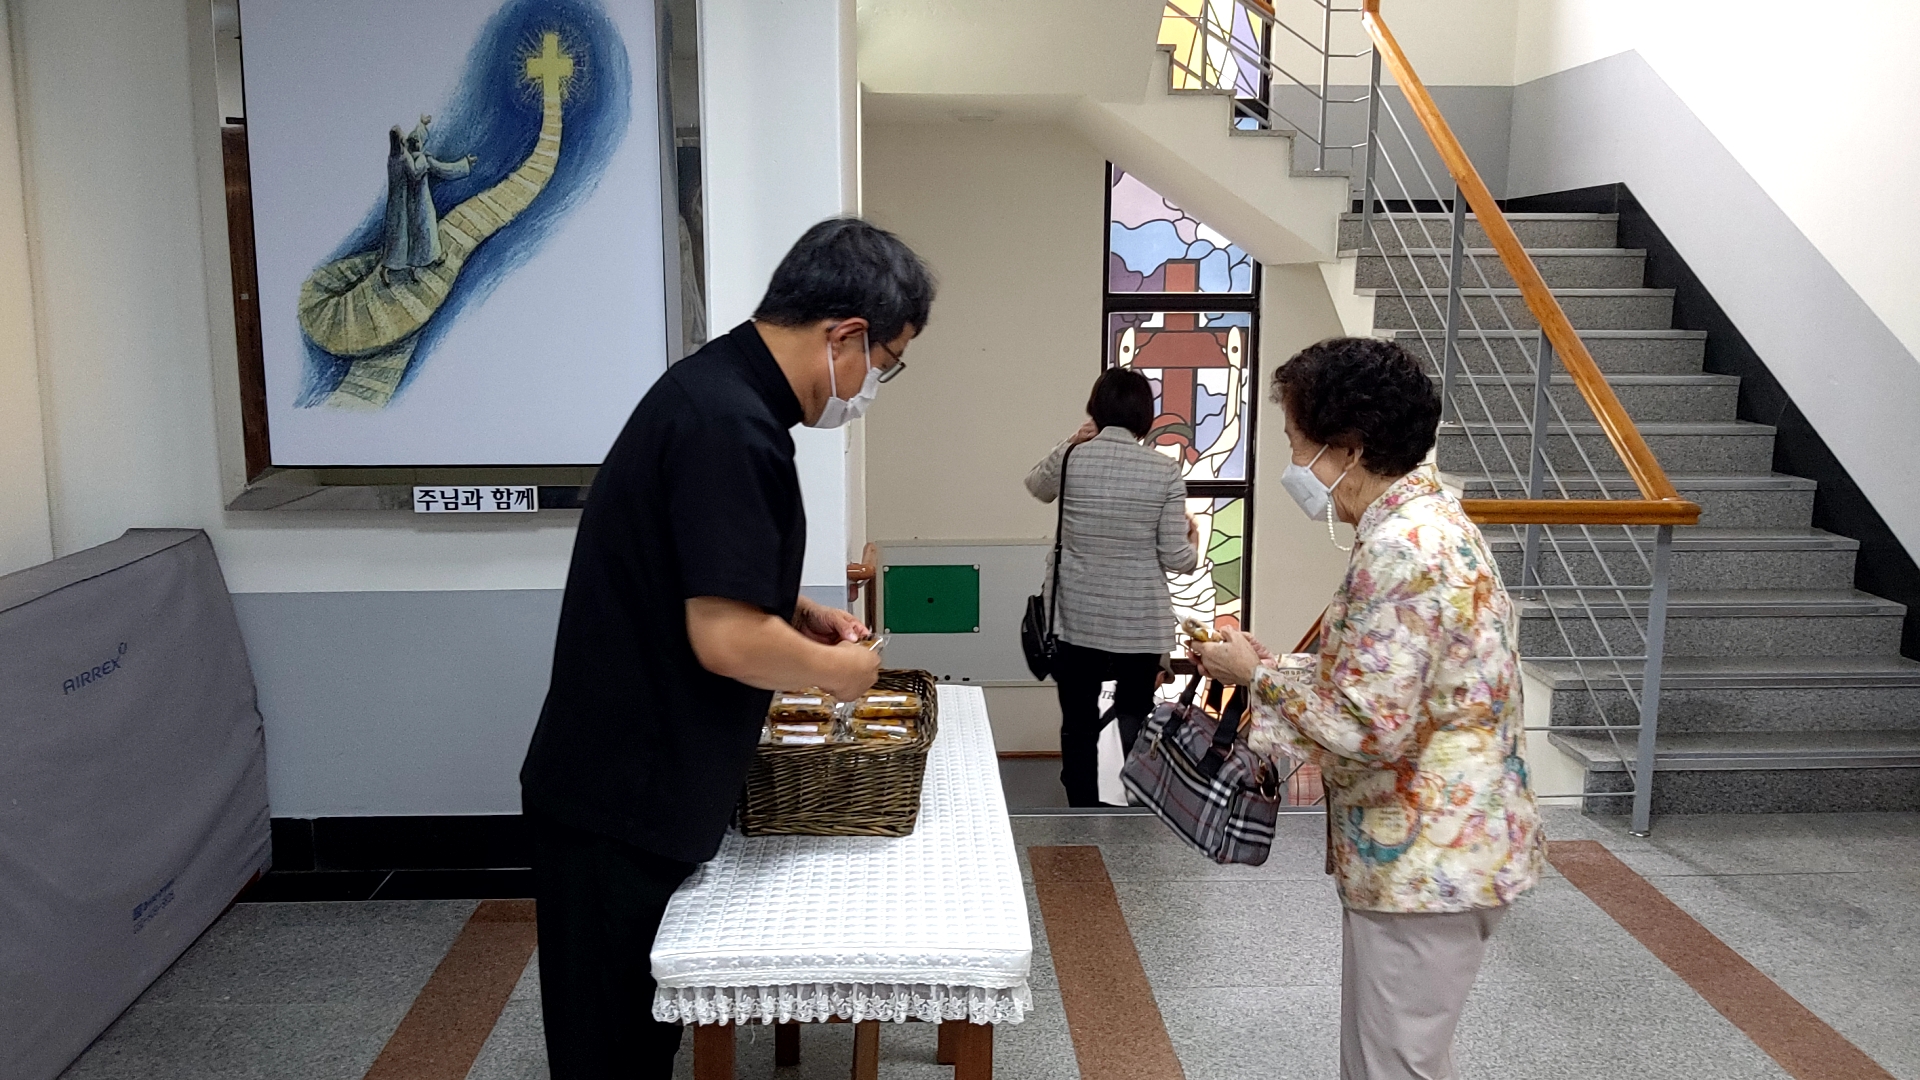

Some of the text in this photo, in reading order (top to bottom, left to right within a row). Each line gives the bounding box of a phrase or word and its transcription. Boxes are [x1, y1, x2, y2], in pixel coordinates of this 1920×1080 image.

[417, 488, 534, 511] 주님과 함께
[63, 655, 121, 695] AIRREX
